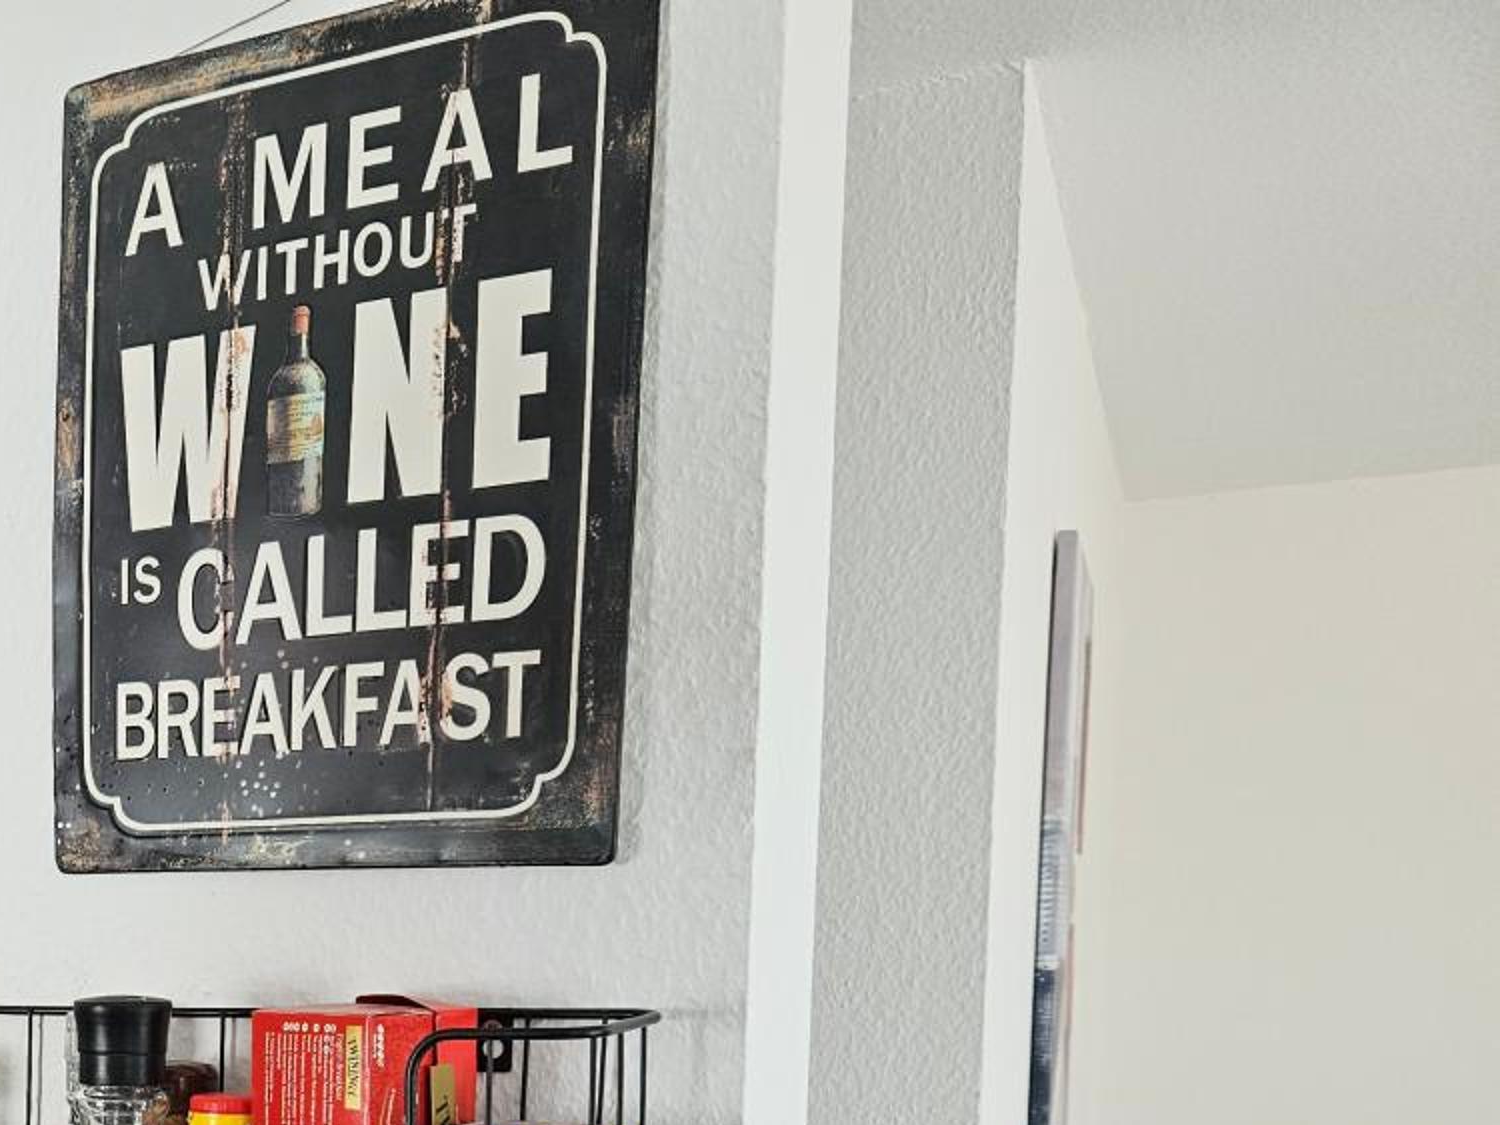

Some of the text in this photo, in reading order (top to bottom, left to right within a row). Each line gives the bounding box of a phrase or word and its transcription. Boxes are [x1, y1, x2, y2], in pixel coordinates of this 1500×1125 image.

[125, 73, 574, 257] A MEAL
[197, 202, 478, 312] WITHOUT
[120, 513, 547, 651] IS CALLED
[115, 649, 542, 762] BREAKFAST
